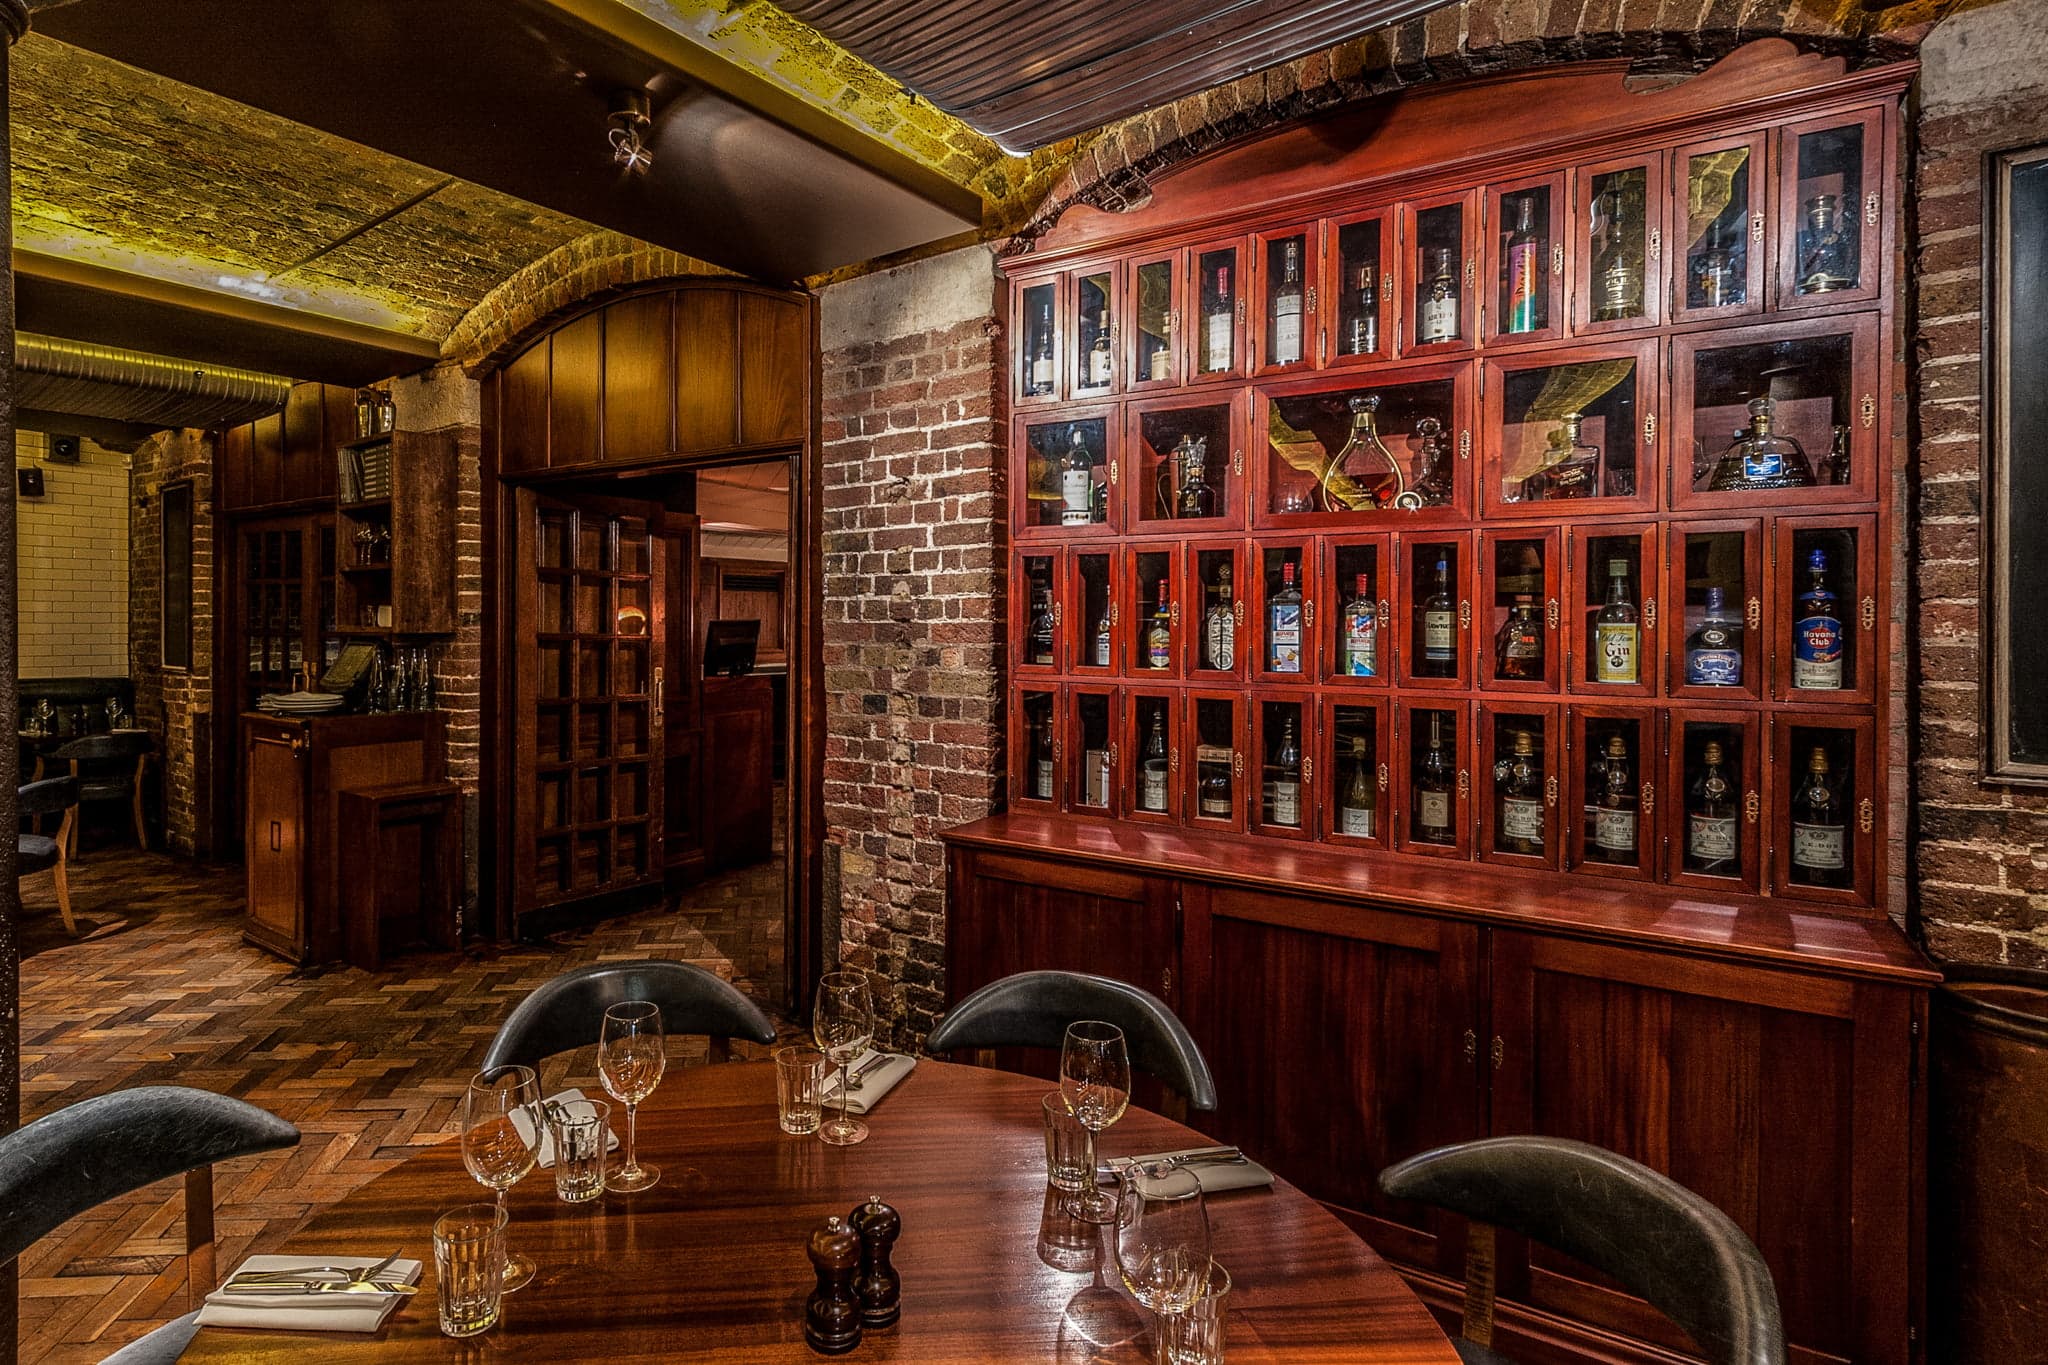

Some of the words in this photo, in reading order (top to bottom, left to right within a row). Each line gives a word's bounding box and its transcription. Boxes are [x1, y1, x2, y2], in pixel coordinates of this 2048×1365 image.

[1803, 631, 1836, 639] Havana
[1810, 638, 1830, 646] Club
[1605, 642, 1630, 657] Gin
